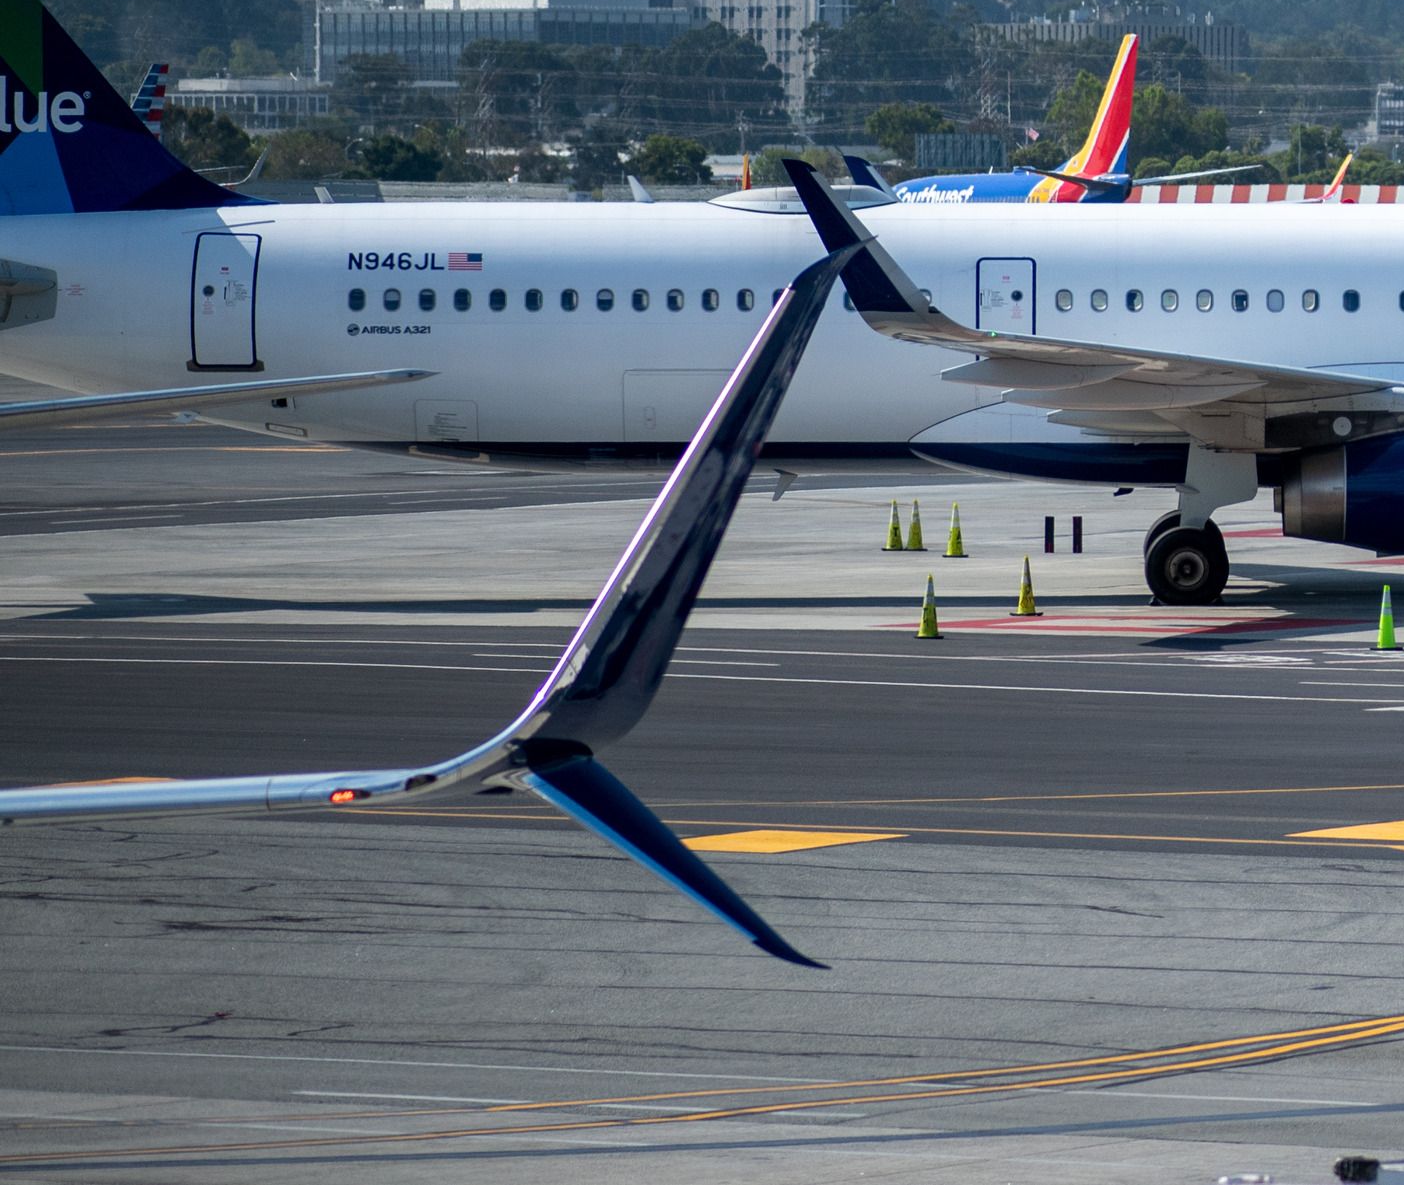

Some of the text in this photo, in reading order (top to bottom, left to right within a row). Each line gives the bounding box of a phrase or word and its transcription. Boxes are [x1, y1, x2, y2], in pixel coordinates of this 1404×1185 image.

[348, 252, 444, 270] N946JL
[361, 326, 431, 334] AIRBUS A321
